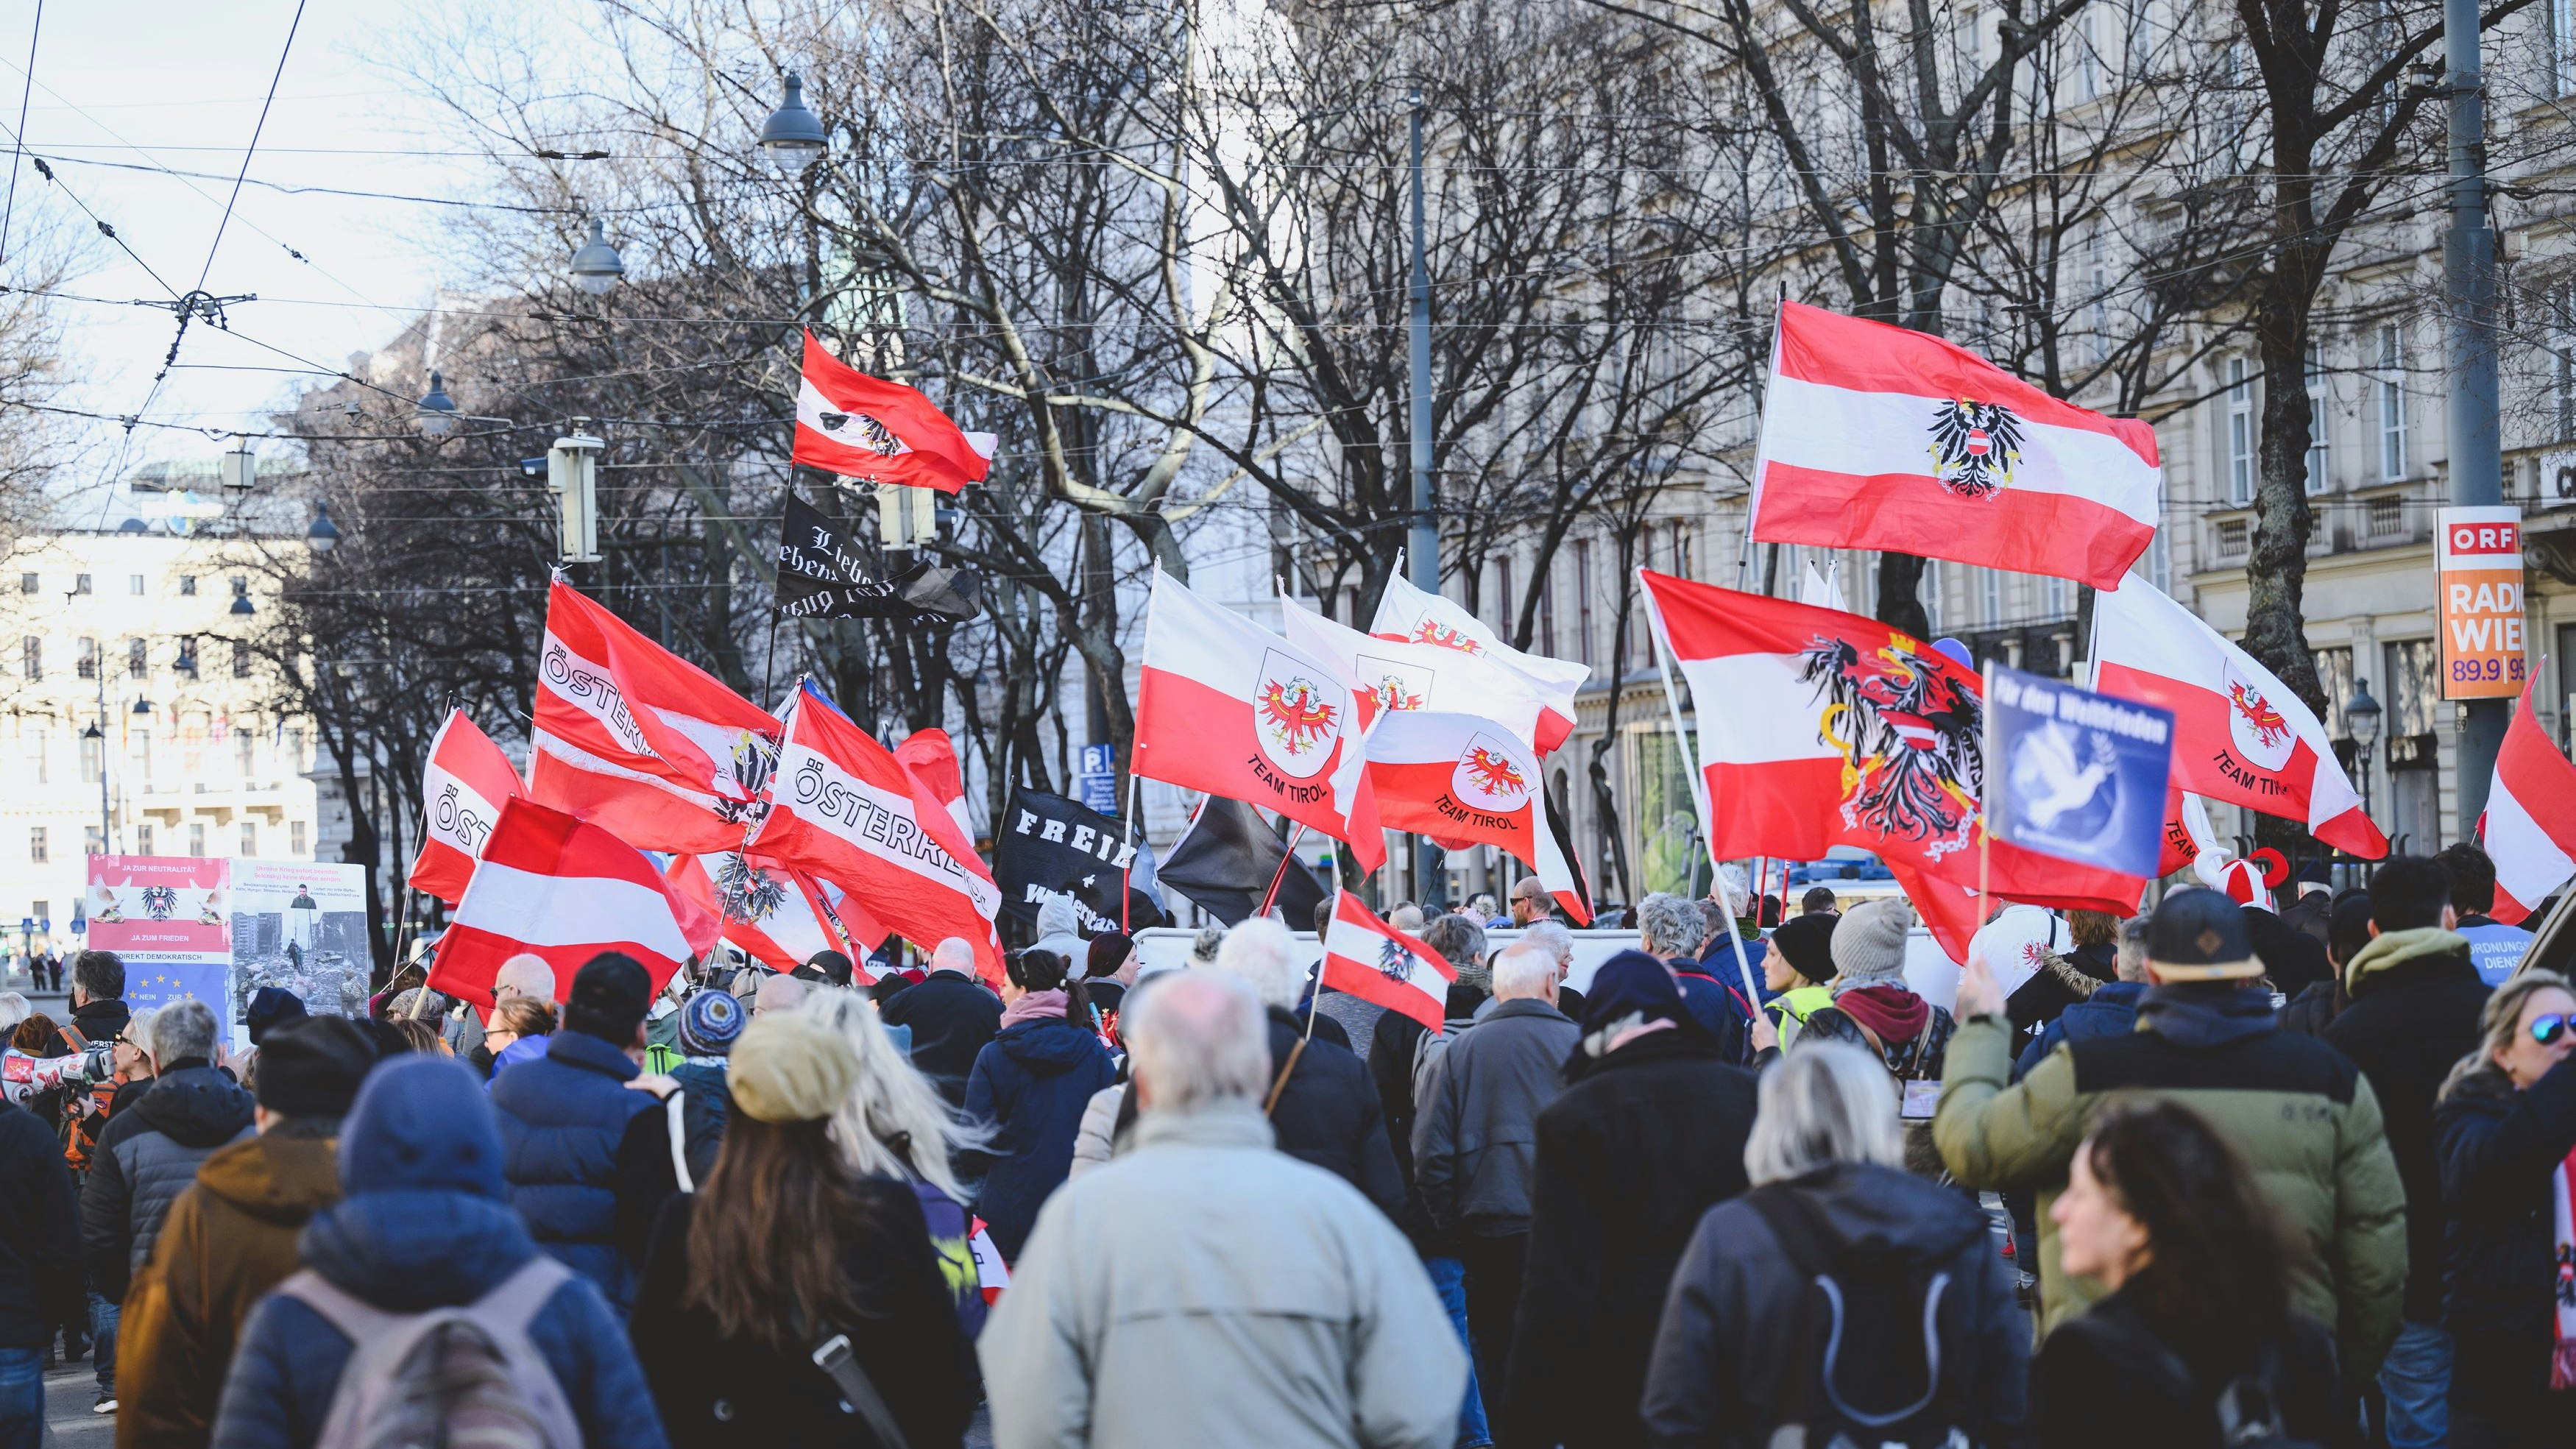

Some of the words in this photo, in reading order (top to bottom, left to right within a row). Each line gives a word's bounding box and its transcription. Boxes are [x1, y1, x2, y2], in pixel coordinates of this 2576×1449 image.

[2454, 528, 2513, 550] ORF
[2452, 659, 2501, 682] 89.9
[1993, 673, 2021, 708] Für
[2020, 682, 2057, 718] den
[2059, 690, 2168, 745] Weltfrieden
[1248, 753, 1286, 796] TEAM
[1288, 783, 1328, 804] TIROL
[2213, 748, 2256, 790] TEAM
[1434, 793, 1470, 823] TEAM
[1472, 813, 1518, 829] TIROL
[2165, 820, 2196, 860] TEAM
[148, 865, 197, 874] NEUTRALITÄT
[279, 866, 294, 874] Krieg
[1024, 883, 1120, 932] Wderstan
[146, 953, 202, 961] DEMOKRATISCH
[2484, 956, 2521, 969] DIENS
